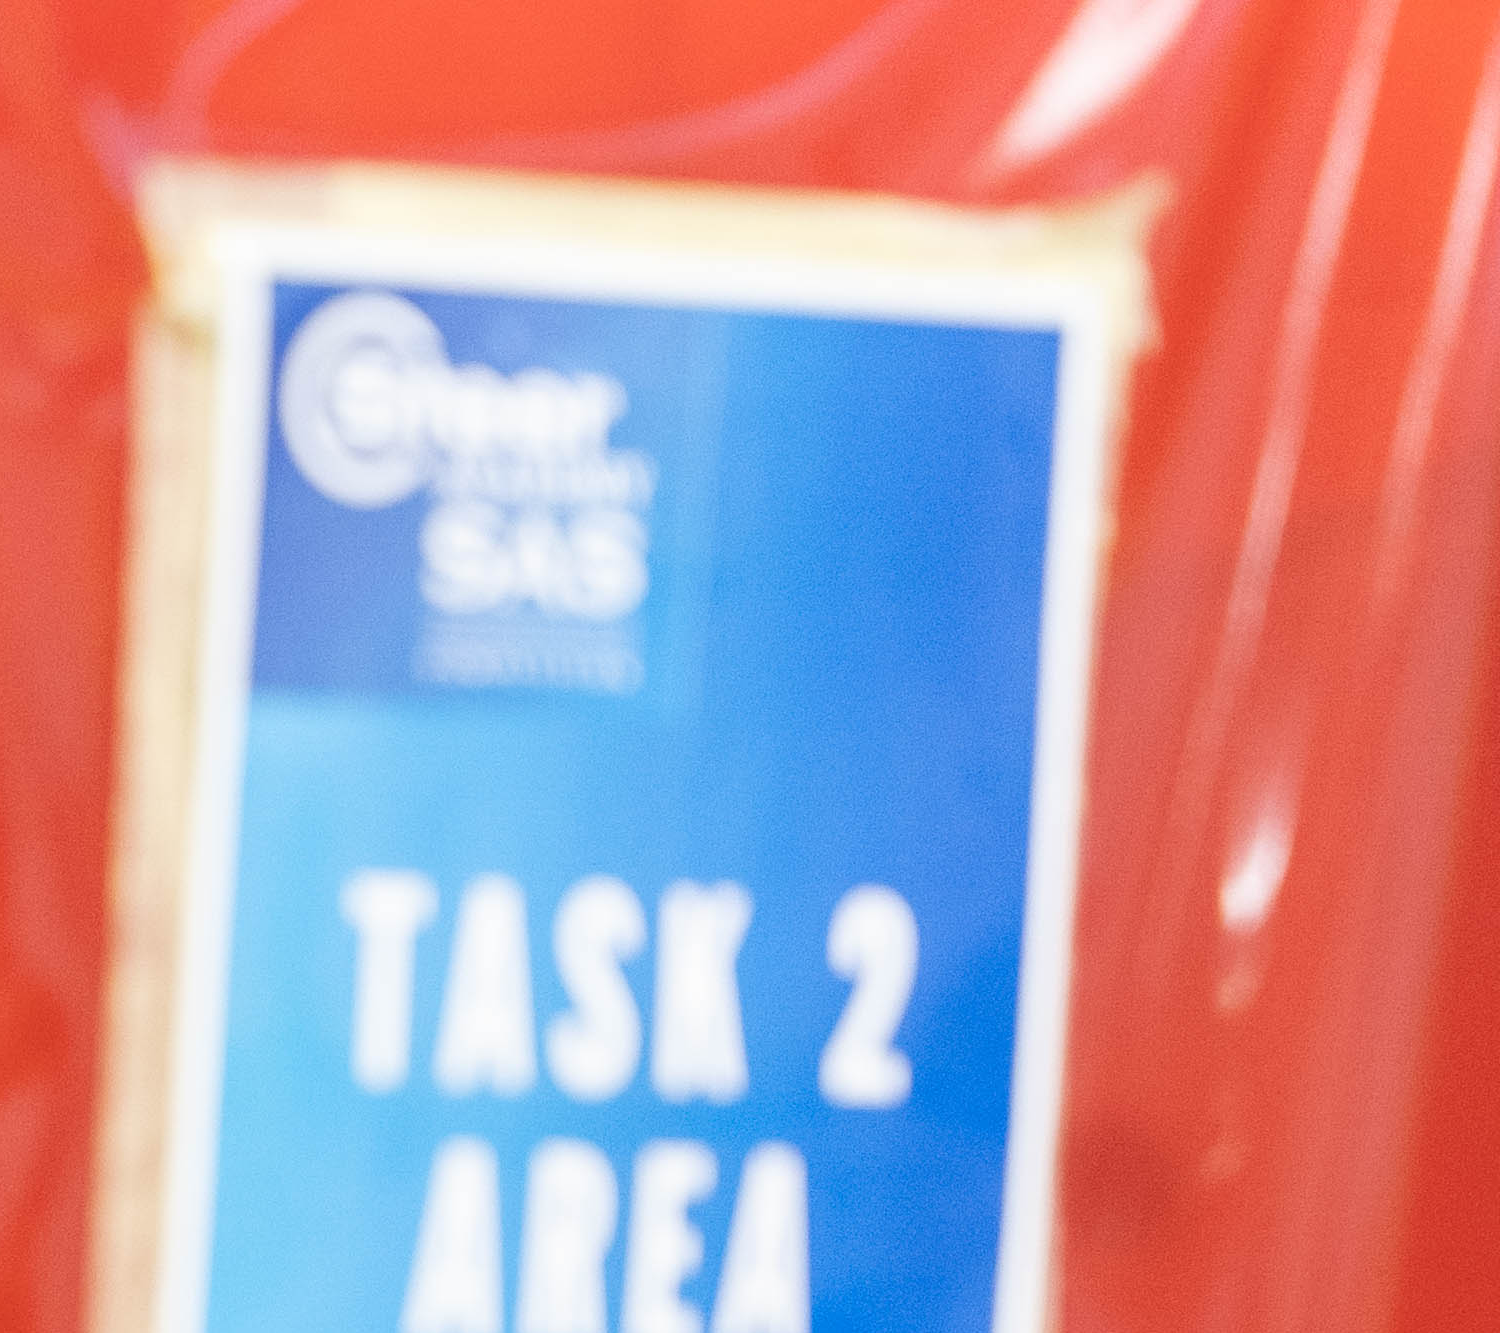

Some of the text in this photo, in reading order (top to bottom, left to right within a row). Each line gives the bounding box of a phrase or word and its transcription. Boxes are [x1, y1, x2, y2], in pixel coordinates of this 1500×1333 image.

[420, 504, 648, 622] SAS
[342, 869, 919, 1108] TASK 2
